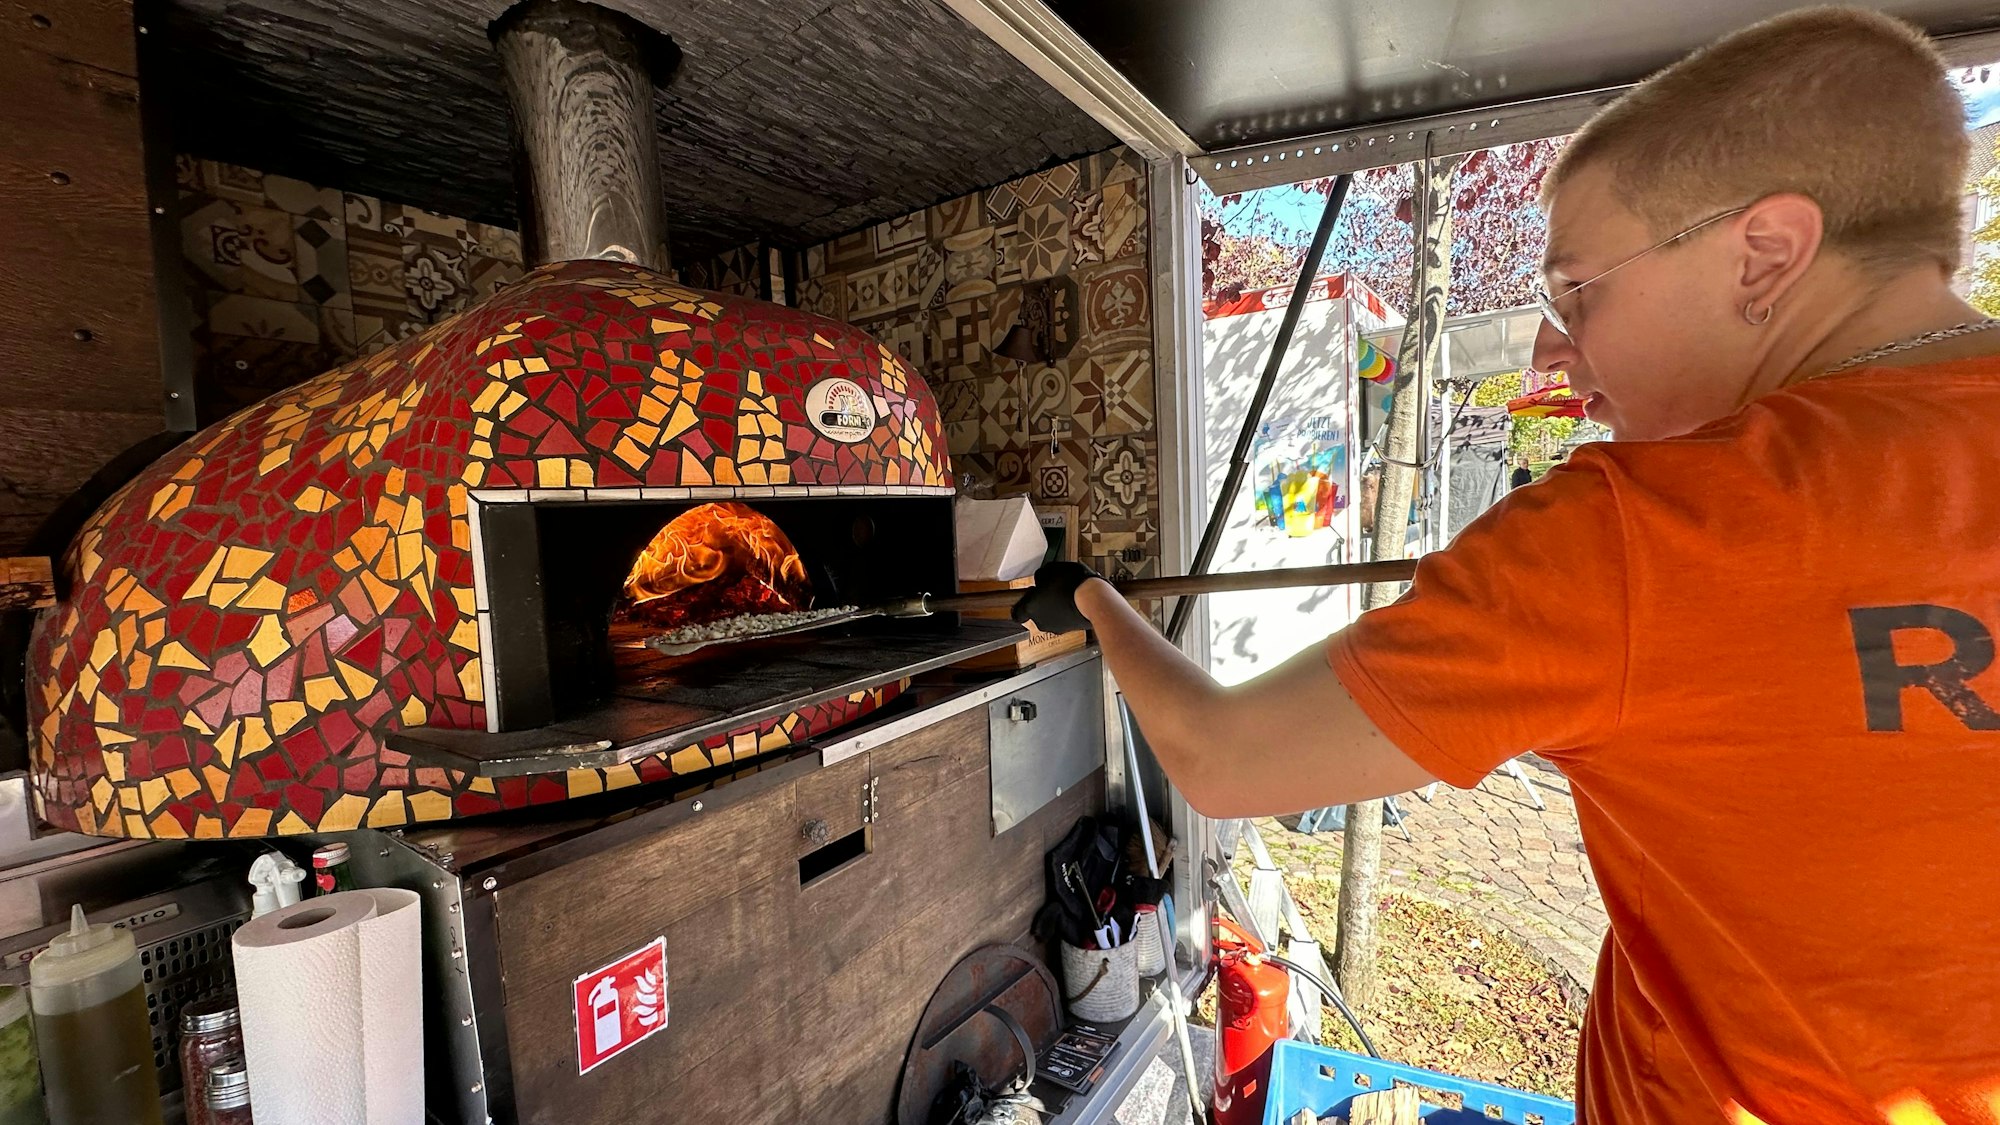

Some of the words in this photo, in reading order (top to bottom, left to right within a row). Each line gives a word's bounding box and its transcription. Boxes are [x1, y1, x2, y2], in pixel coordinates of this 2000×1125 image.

[837, 414, 861, 427] FORNI
[1307, 416, 1331, 429] JETZT
[1847, 604, 2000, 731] R
[113, 910, 166, 929] stro
